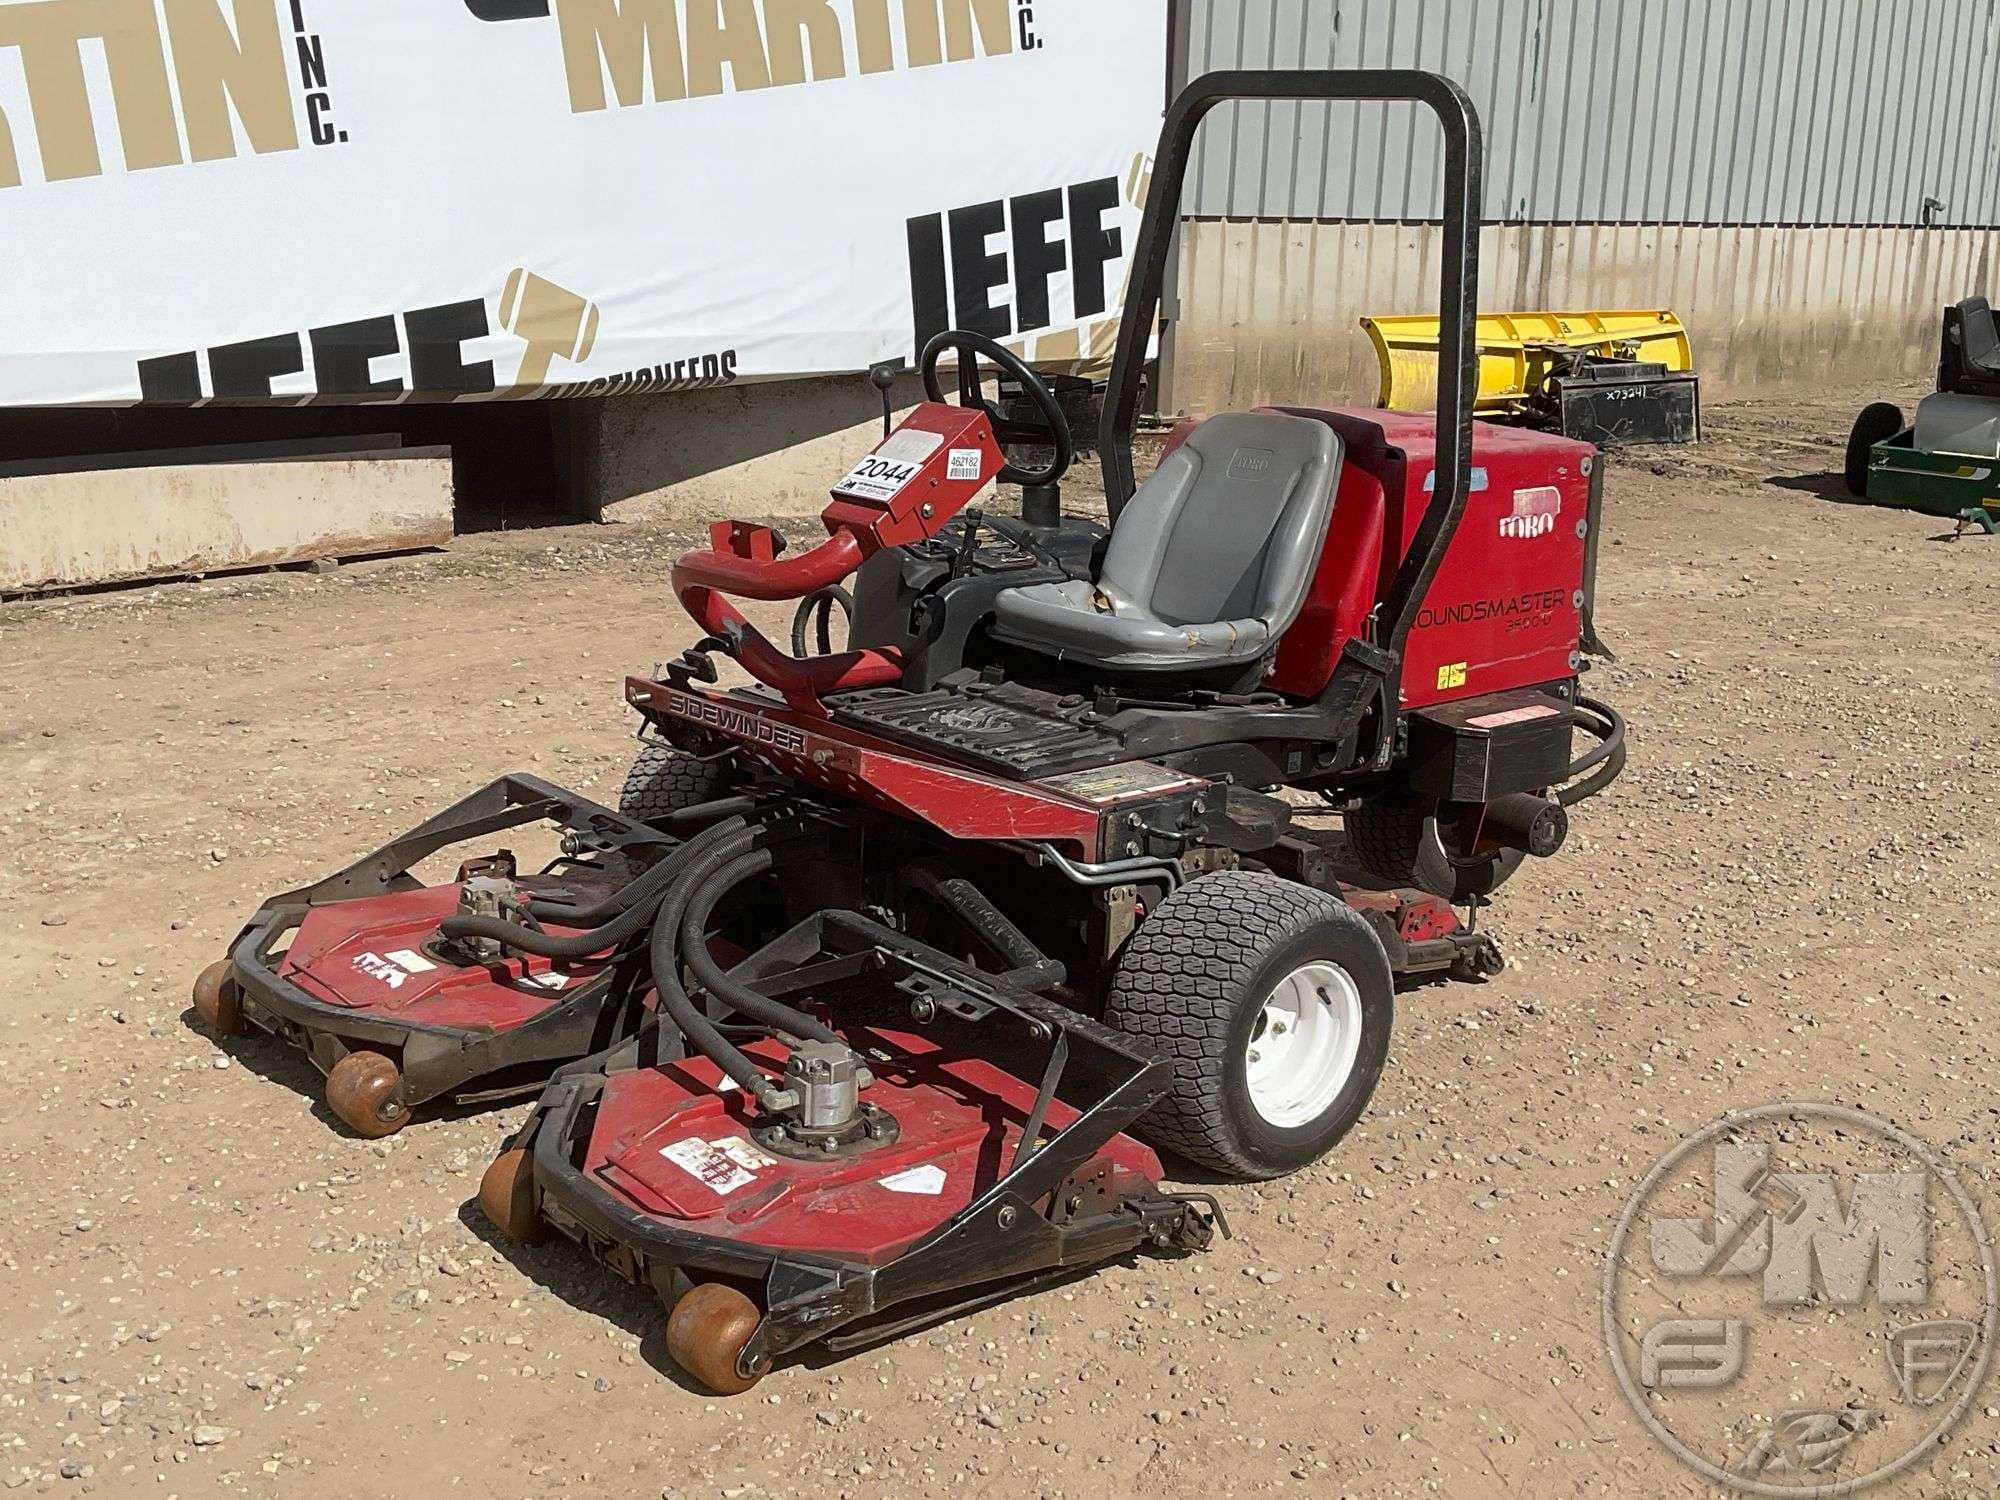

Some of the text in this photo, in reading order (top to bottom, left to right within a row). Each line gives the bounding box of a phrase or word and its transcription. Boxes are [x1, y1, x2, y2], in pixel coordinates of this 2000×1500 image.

[0, 0, 299, 189] TIN
[854, 459, 915, 484] 2044
[1411, 588, 1566, 630] OUNDSMASTER
[669, 694, 808, 757] SIDEWINDER
